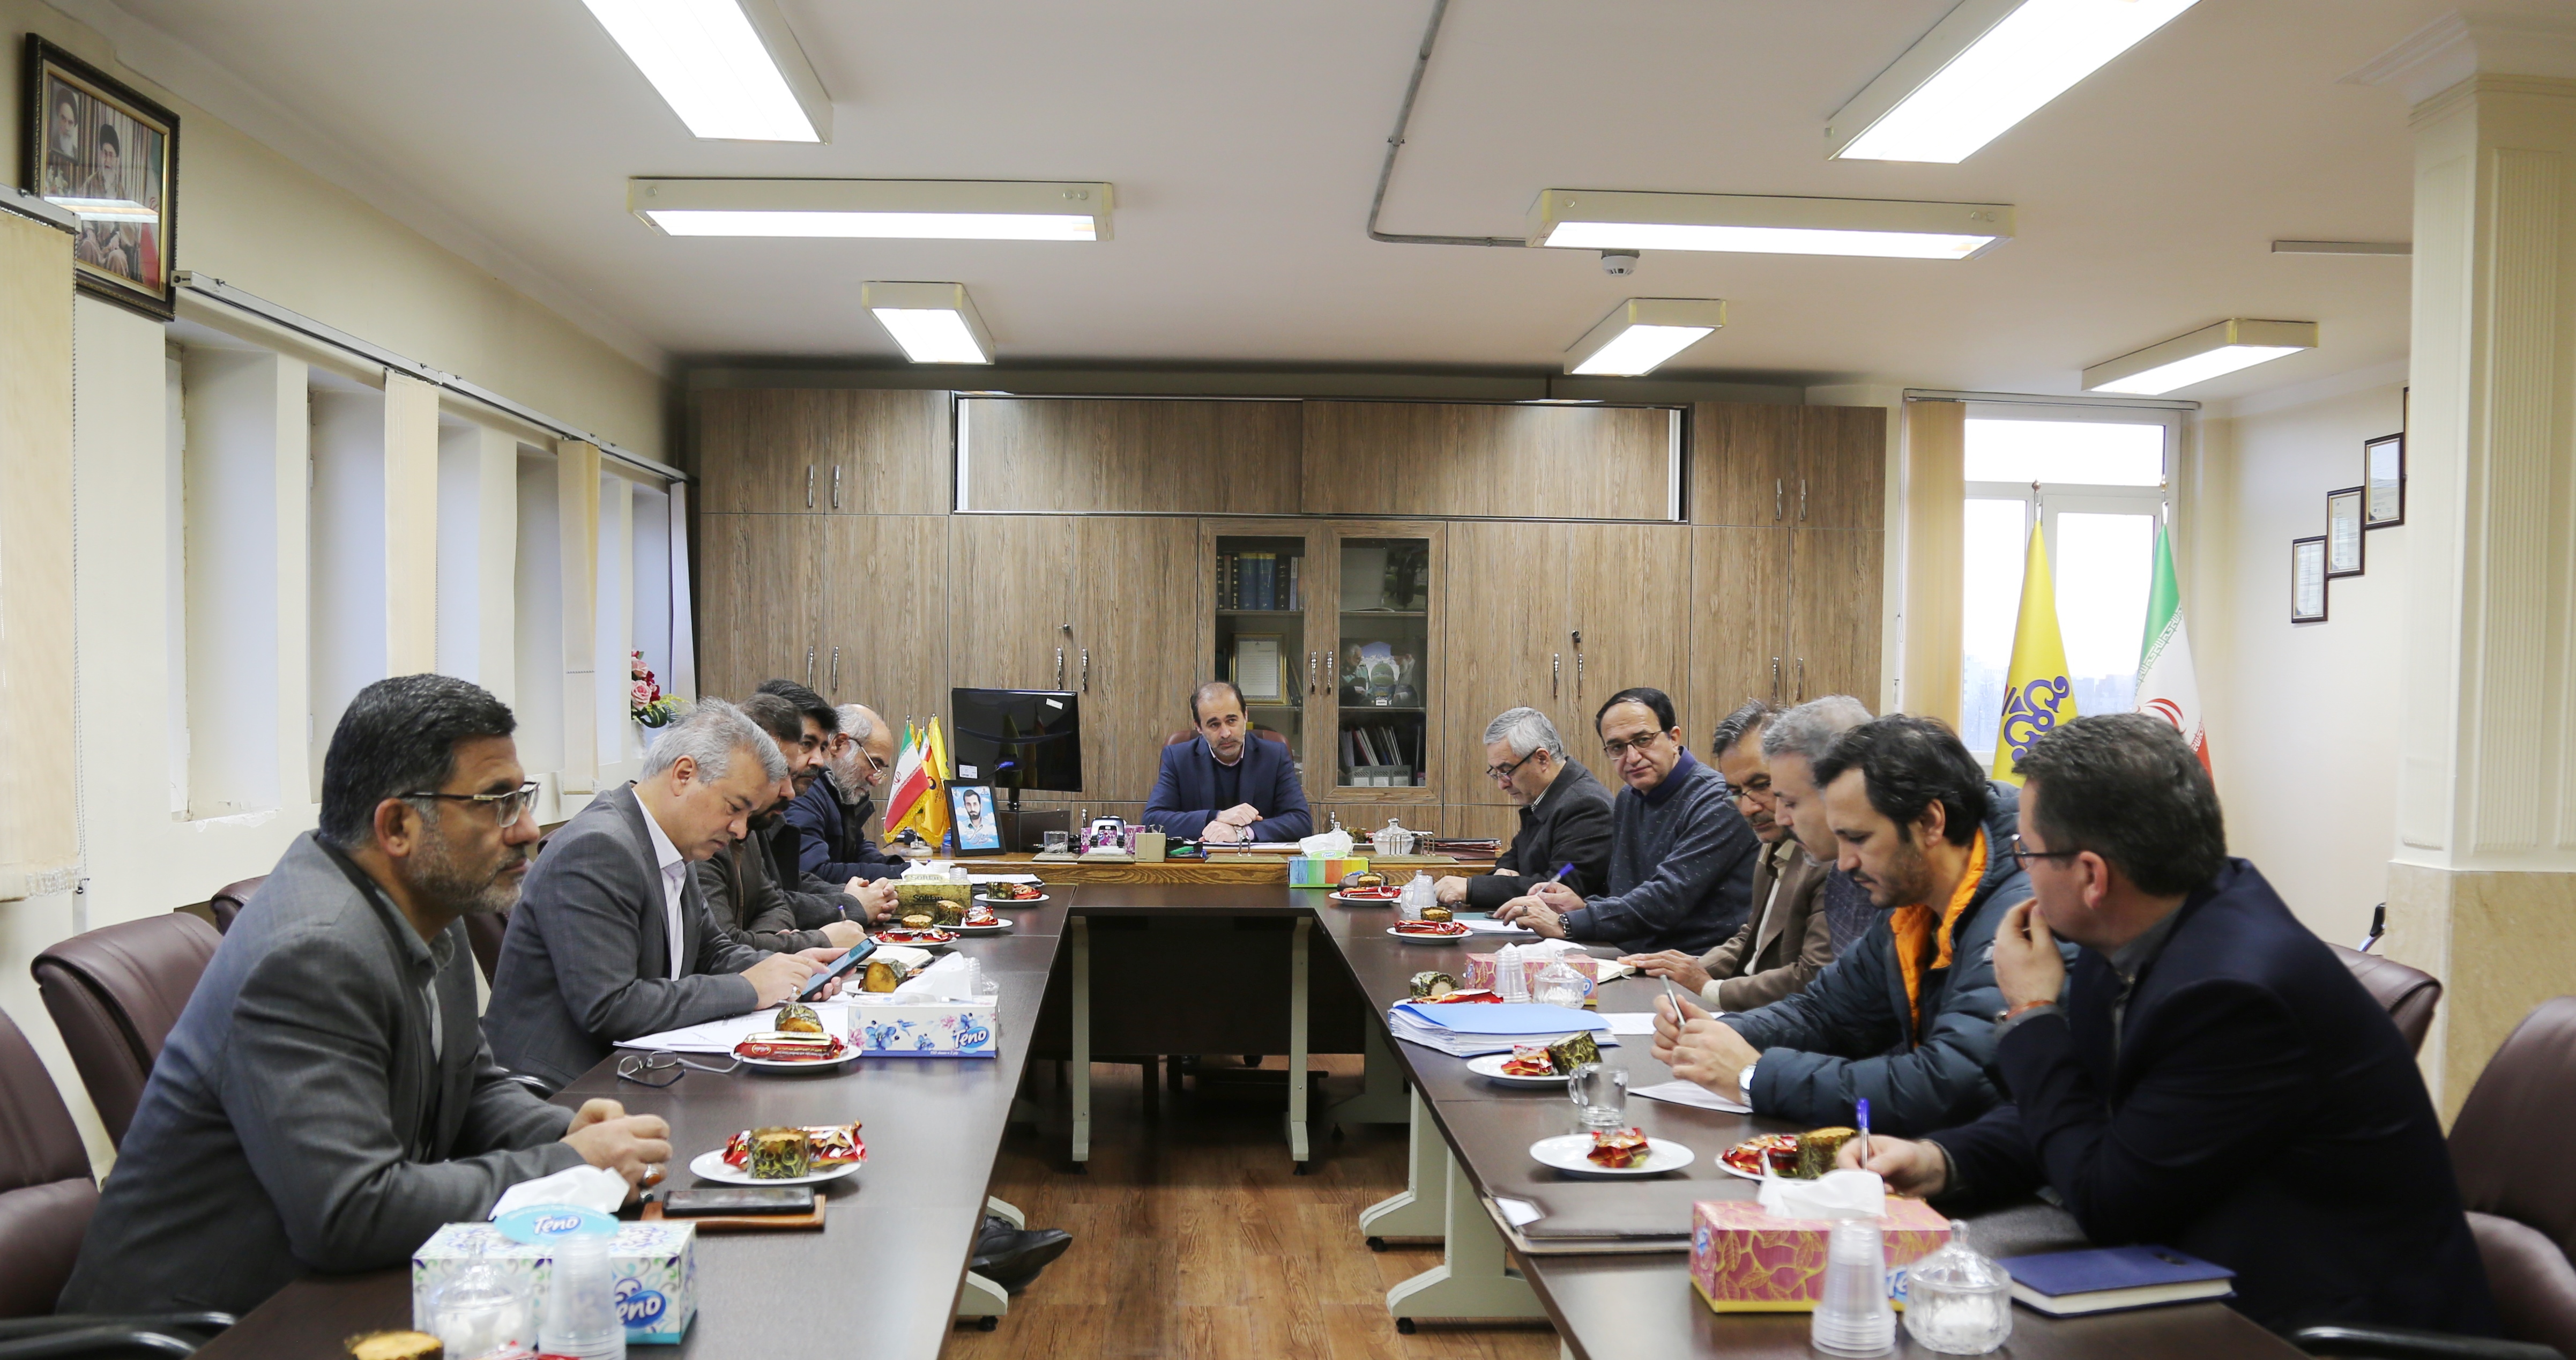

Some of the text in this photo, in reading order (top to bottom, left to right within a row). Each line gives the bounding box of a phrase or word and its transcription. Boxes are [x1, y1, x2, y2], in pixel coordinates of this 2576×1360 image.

[953, 1029, 987, 1048] Teno
[534, 1214, 579, 1234] Teno
[615, 1295, 662, 1325] eno
